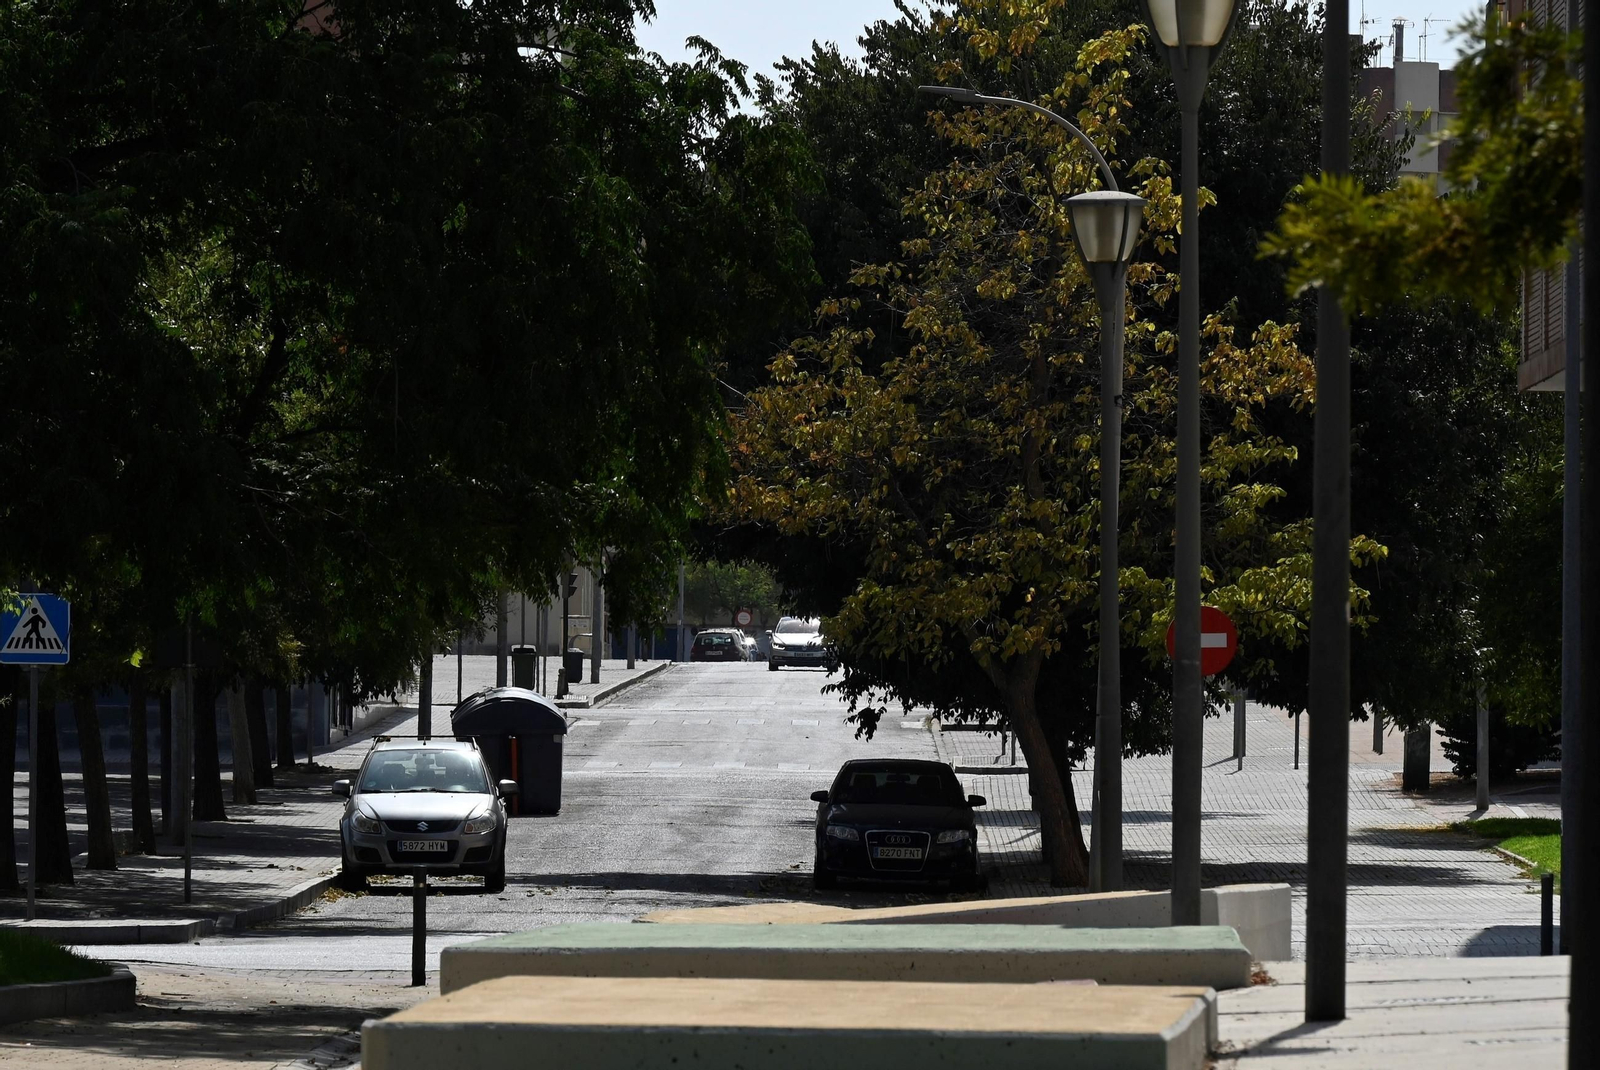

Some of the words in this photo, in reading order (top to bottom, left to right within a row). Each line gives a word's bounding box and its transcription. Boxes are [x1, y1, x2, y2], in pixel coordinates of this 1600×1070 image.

[403, 841, 426, 850] 5872
[880, 848, 902, 857] 8270
[904, 849, 921, 858] FNT
